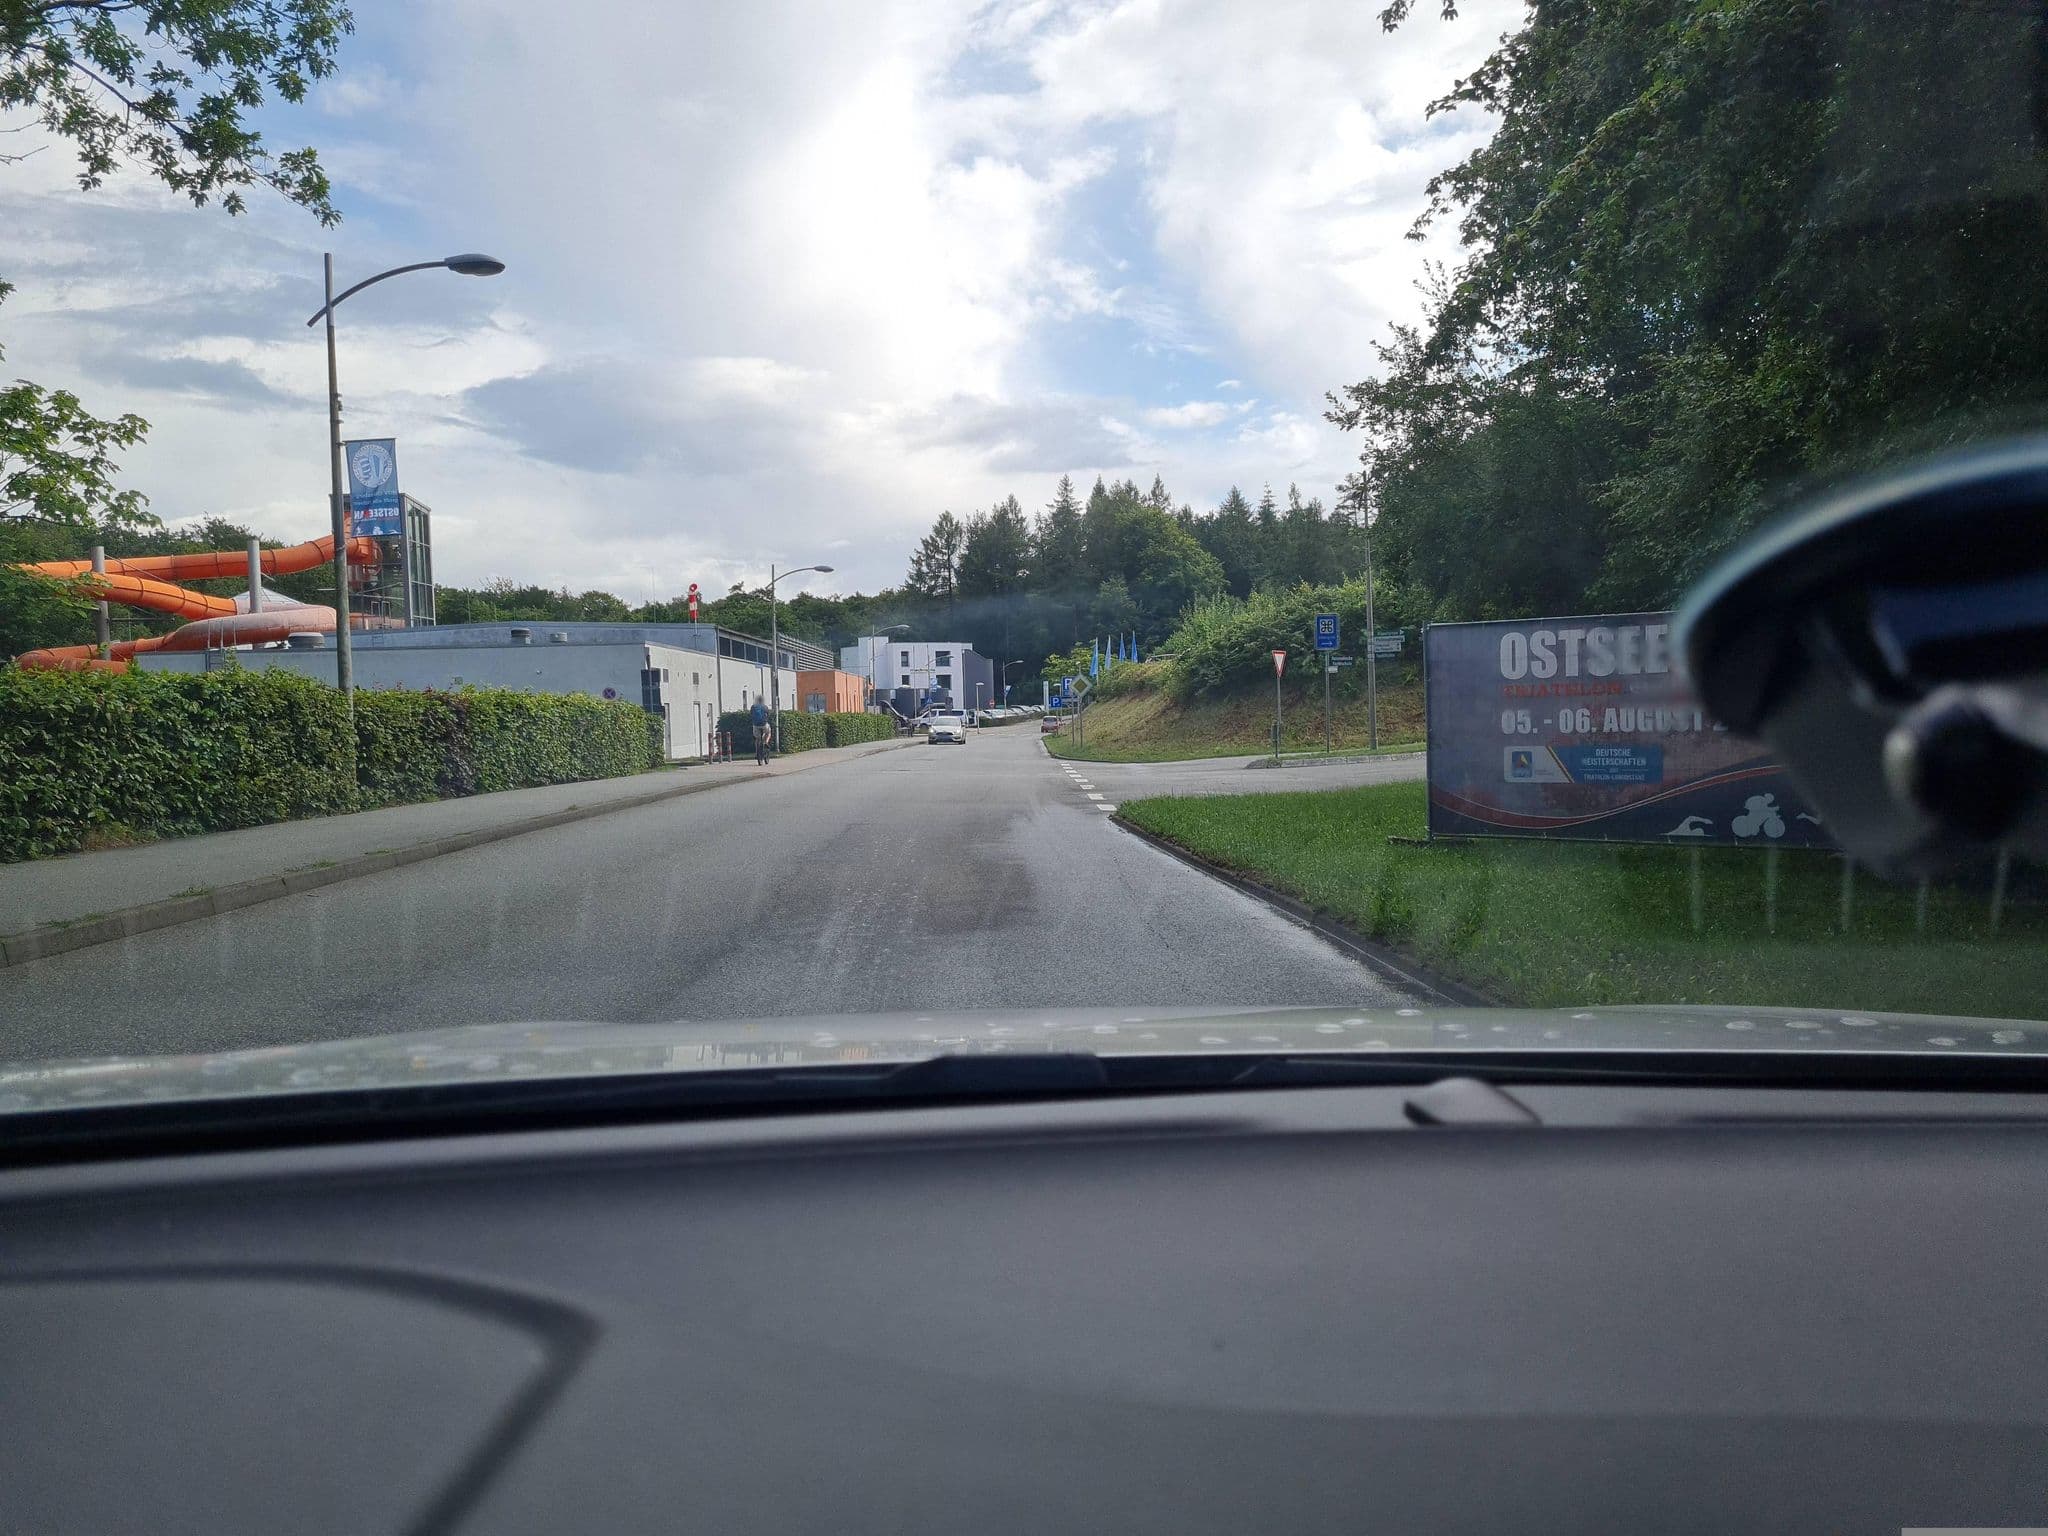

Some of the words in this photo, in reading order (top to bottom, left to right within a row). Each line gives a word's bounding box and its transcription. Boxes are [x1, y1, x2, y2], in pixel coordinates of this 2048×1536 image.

[1501, 709, 1538, 735] 05.
[1558, 707, 1597, 734] 06.
[1602, 706, 1702, 734] AUGUST
[1595, 748, 1632, 757] DEUTSCHE
